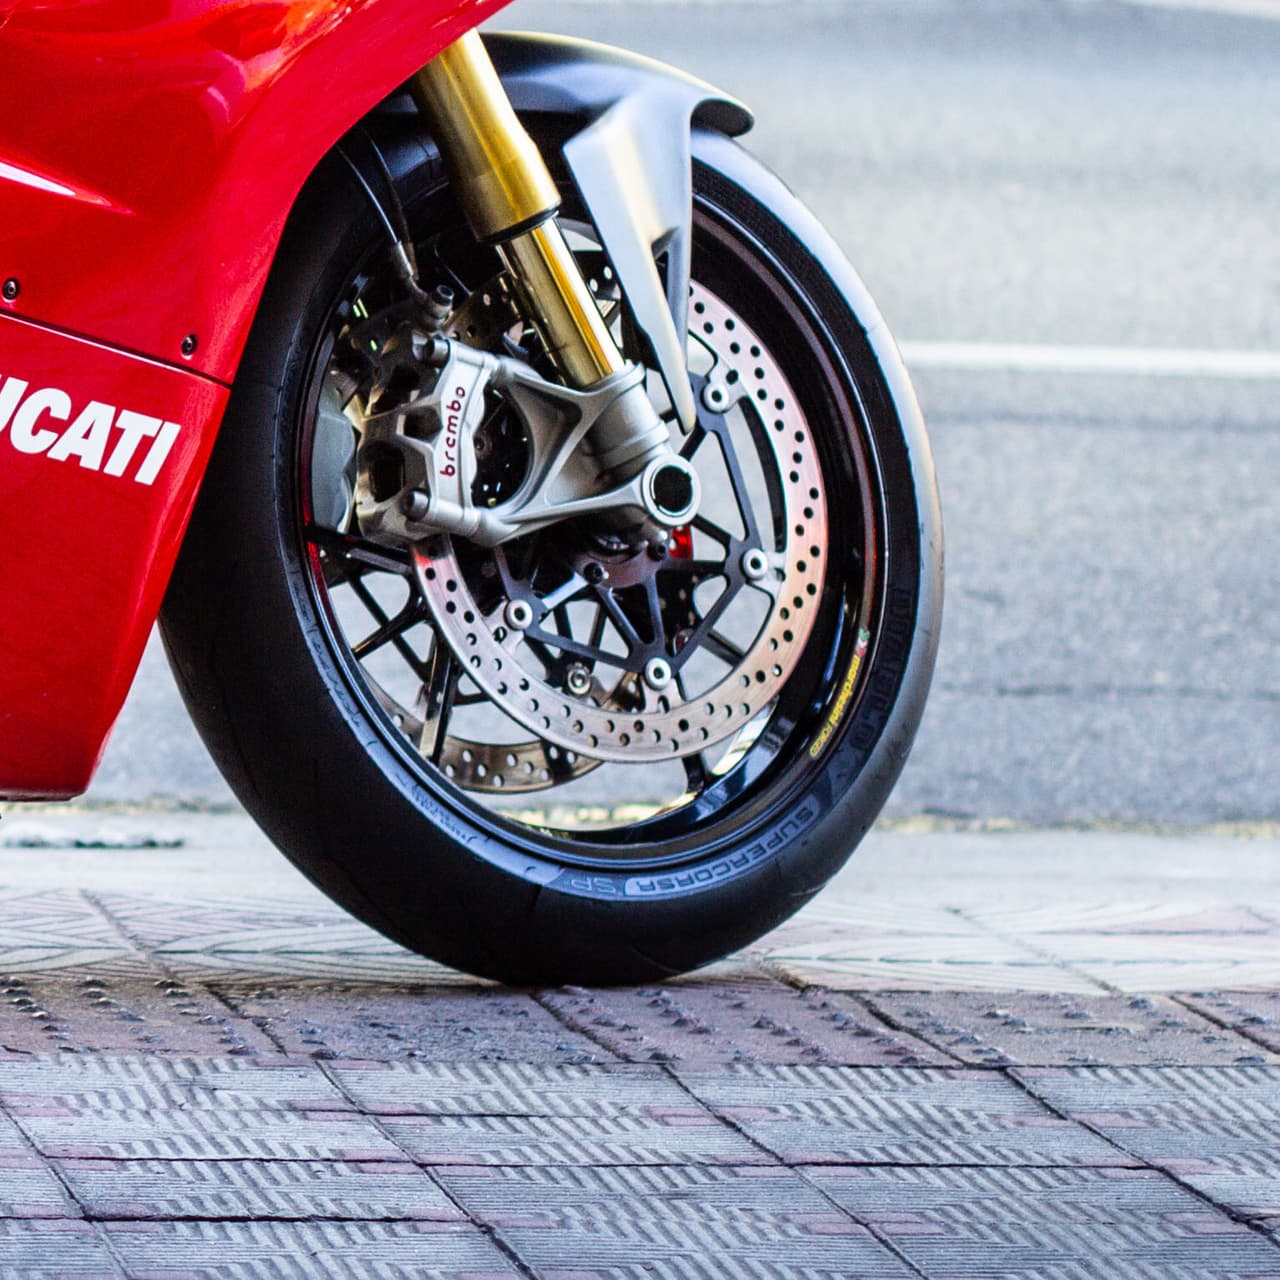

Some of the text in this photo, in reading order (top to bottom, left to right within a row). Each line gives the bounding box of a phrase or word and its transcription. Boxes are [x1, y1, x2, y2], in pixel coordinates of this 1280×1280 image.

[440, 386, 466, 477] brembo
[570, 804, 815, 894] SUPERCORSA SP
